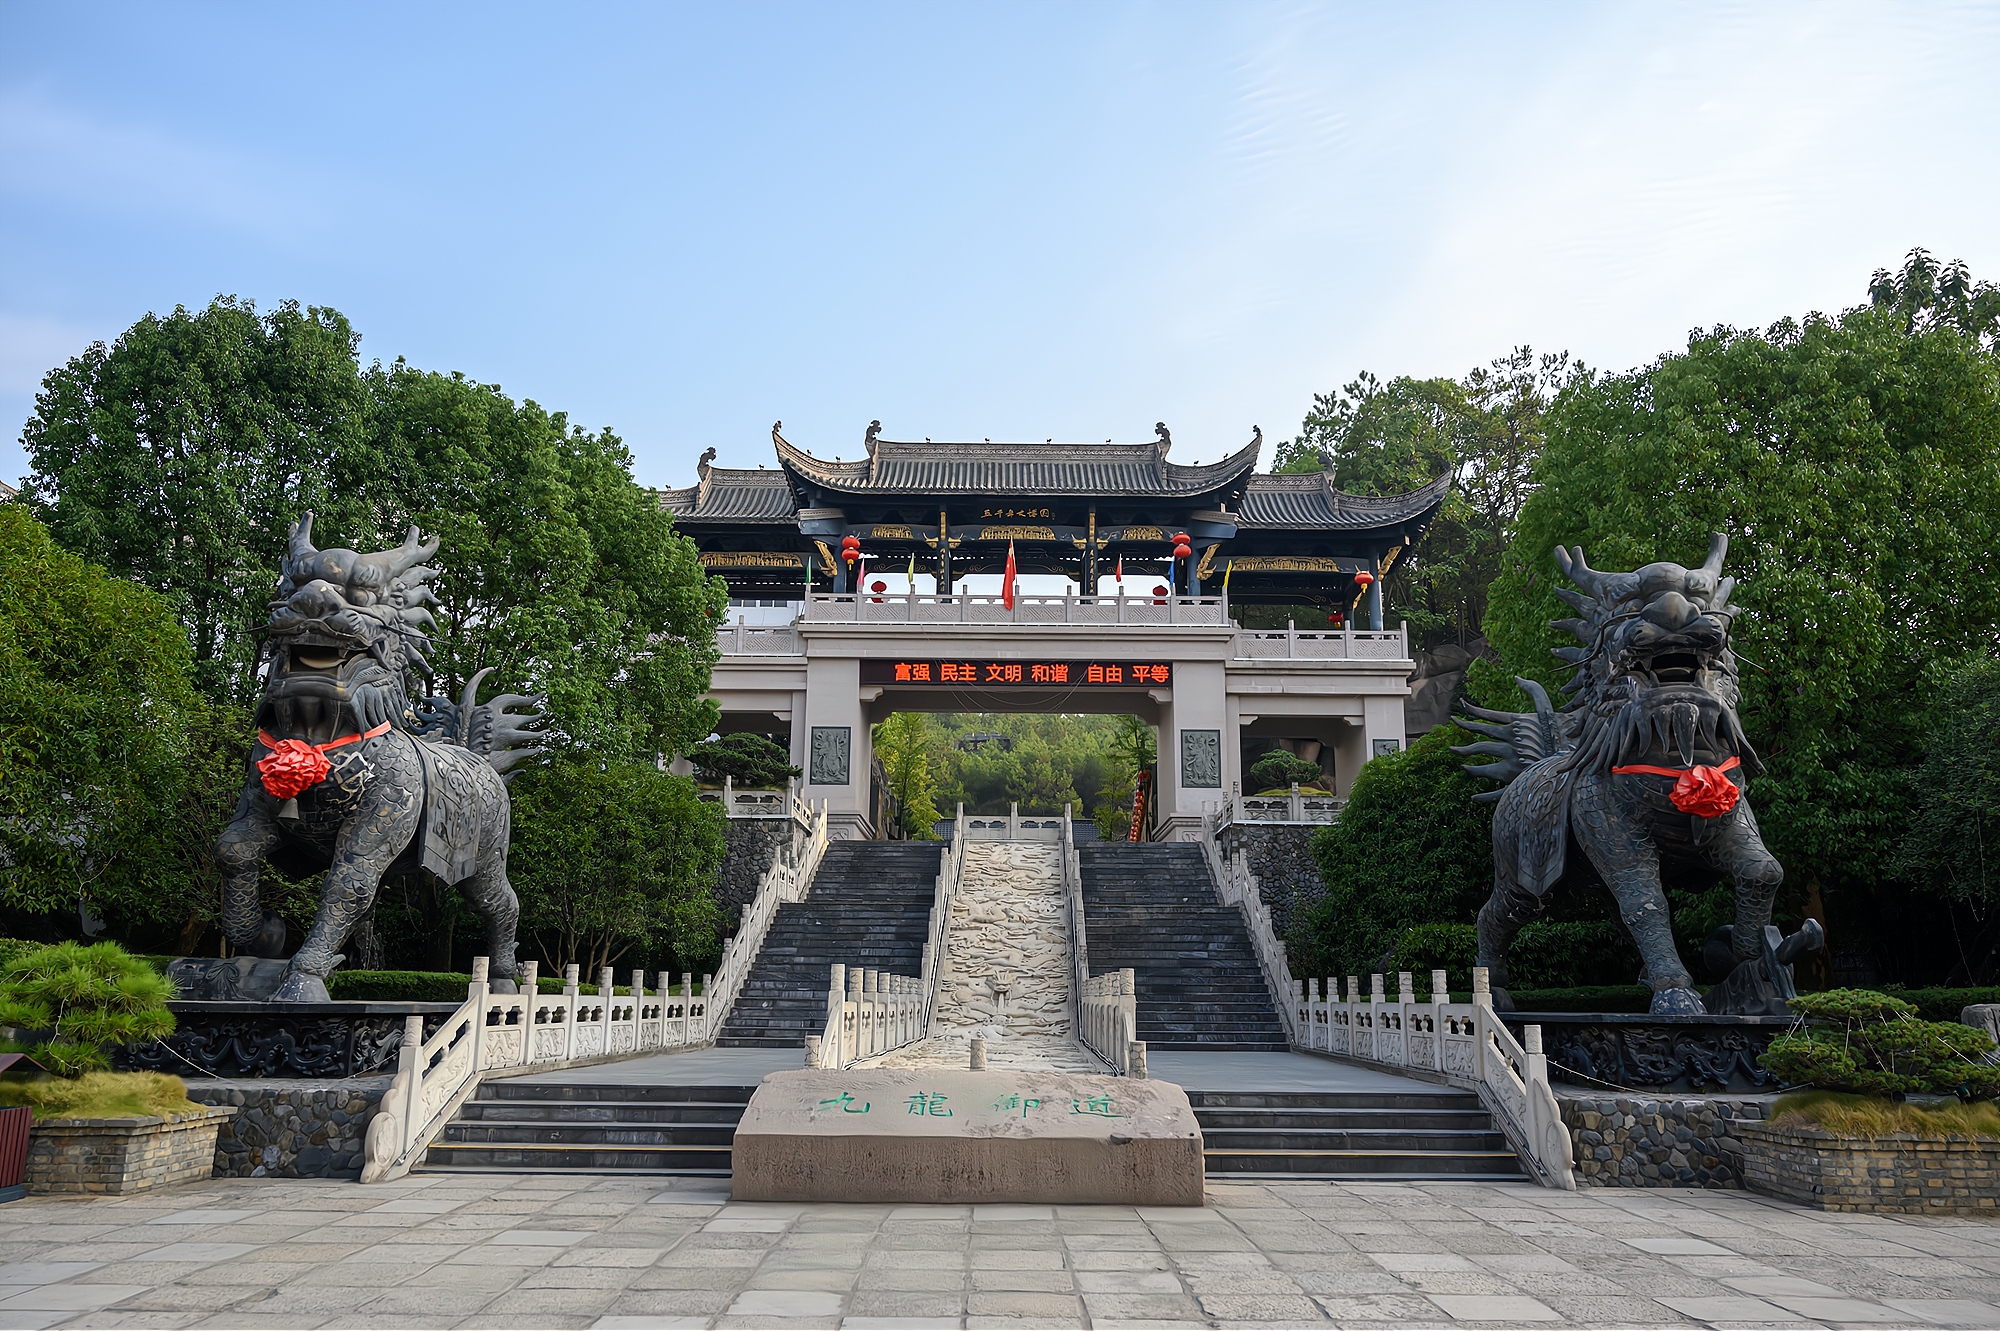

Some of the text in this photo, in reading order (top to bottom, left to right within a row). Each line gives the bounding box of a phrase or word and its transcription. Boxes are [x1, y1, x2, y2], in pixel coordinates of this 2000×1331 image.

[894, 663, 1169, 684] 富强 民主 文明 和谐 自由 平等
[817, 1091, 1125, 1119] 九龍御道
